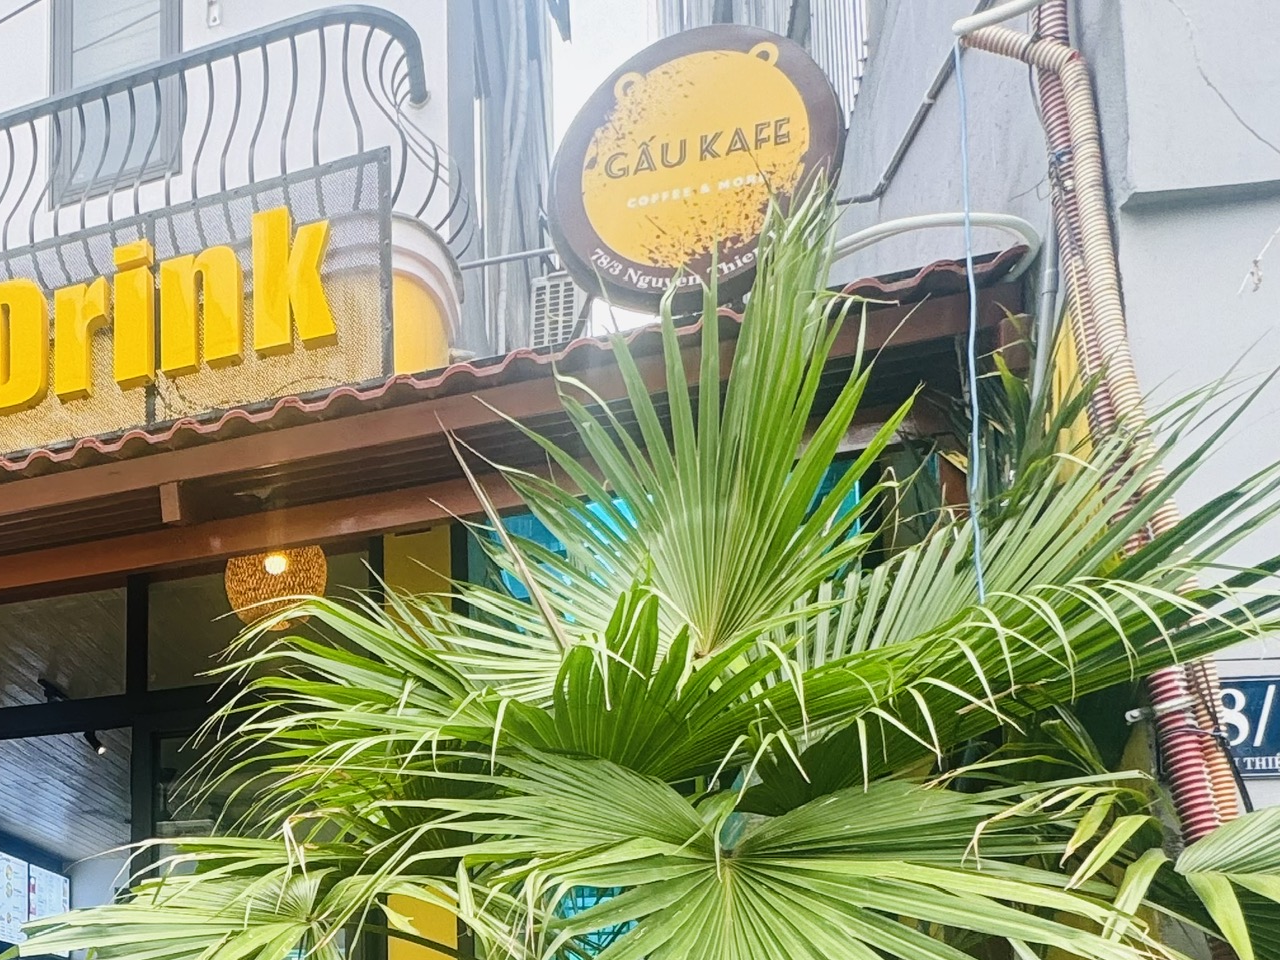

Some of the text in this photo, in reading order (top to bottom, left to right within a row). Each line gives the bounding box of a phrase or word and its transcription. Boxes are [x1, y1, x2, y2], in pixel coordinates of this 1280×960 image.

[604, 117, 791, 179] GẤU KAFE
[627, 187, 692, 209] COFFEE
[590, 248, 622, 275] 78/3
